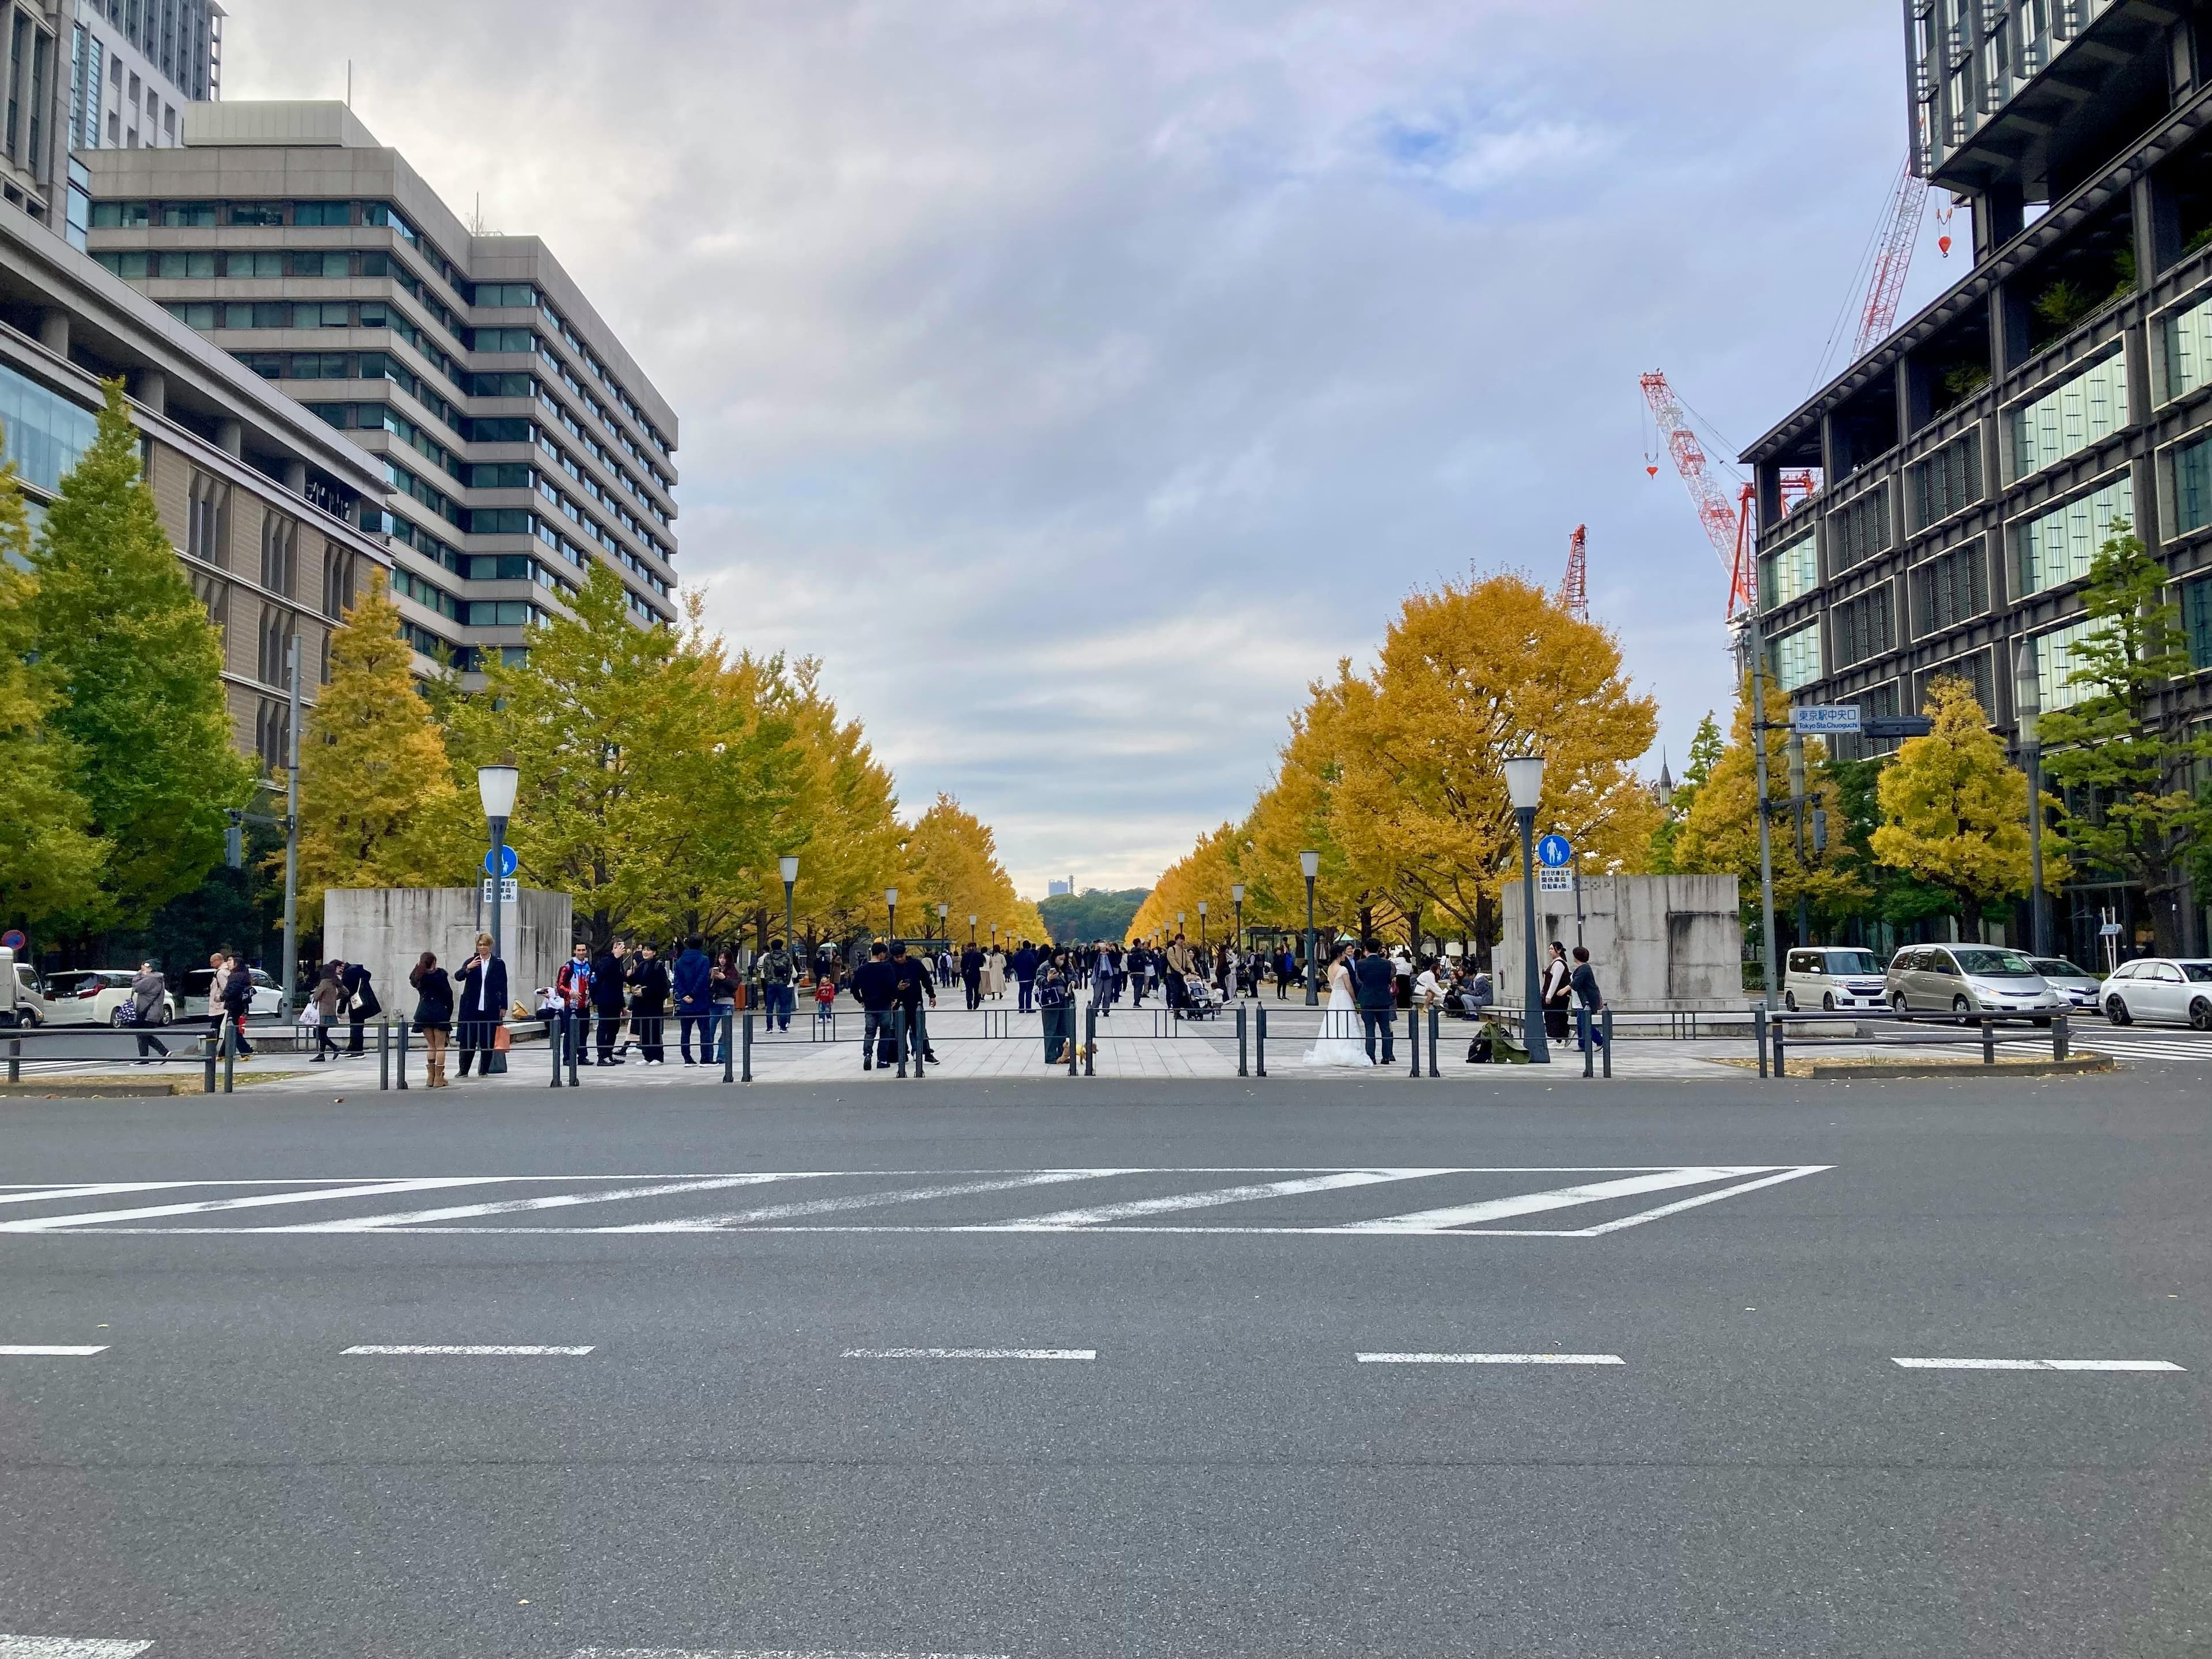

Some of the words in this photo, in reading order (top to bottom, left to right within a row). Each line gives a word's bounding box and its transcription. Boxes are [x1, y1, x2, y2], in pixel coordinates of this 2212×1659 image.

[1799, 710, 1856, 721] 東京駅中央口
